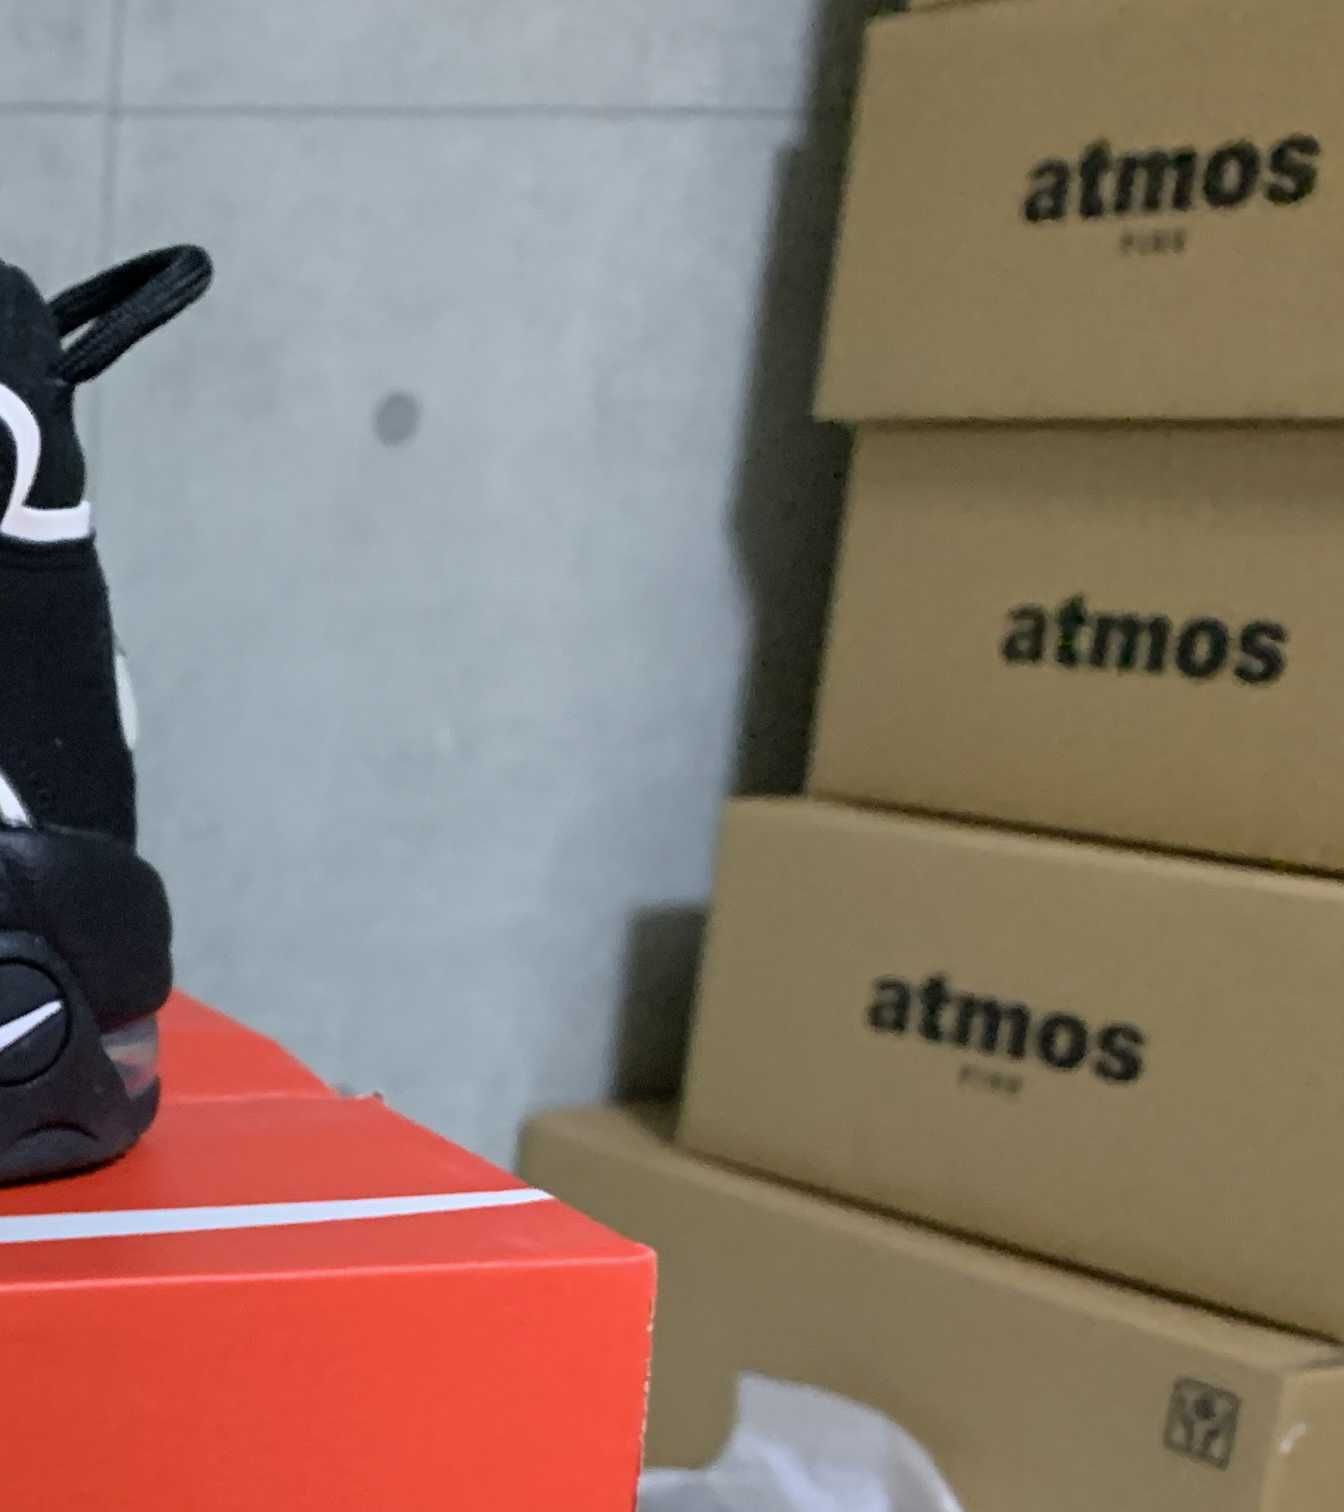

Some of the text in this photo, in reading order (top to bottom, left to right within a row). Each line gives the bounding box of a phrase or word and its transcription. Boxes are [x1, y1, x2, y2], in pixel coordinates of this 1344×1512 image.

[1023, 134, 1321, 223] atmos
[1002, 593, 1289, 685] atmos
[866, 972, 1149, 1084] atmos
